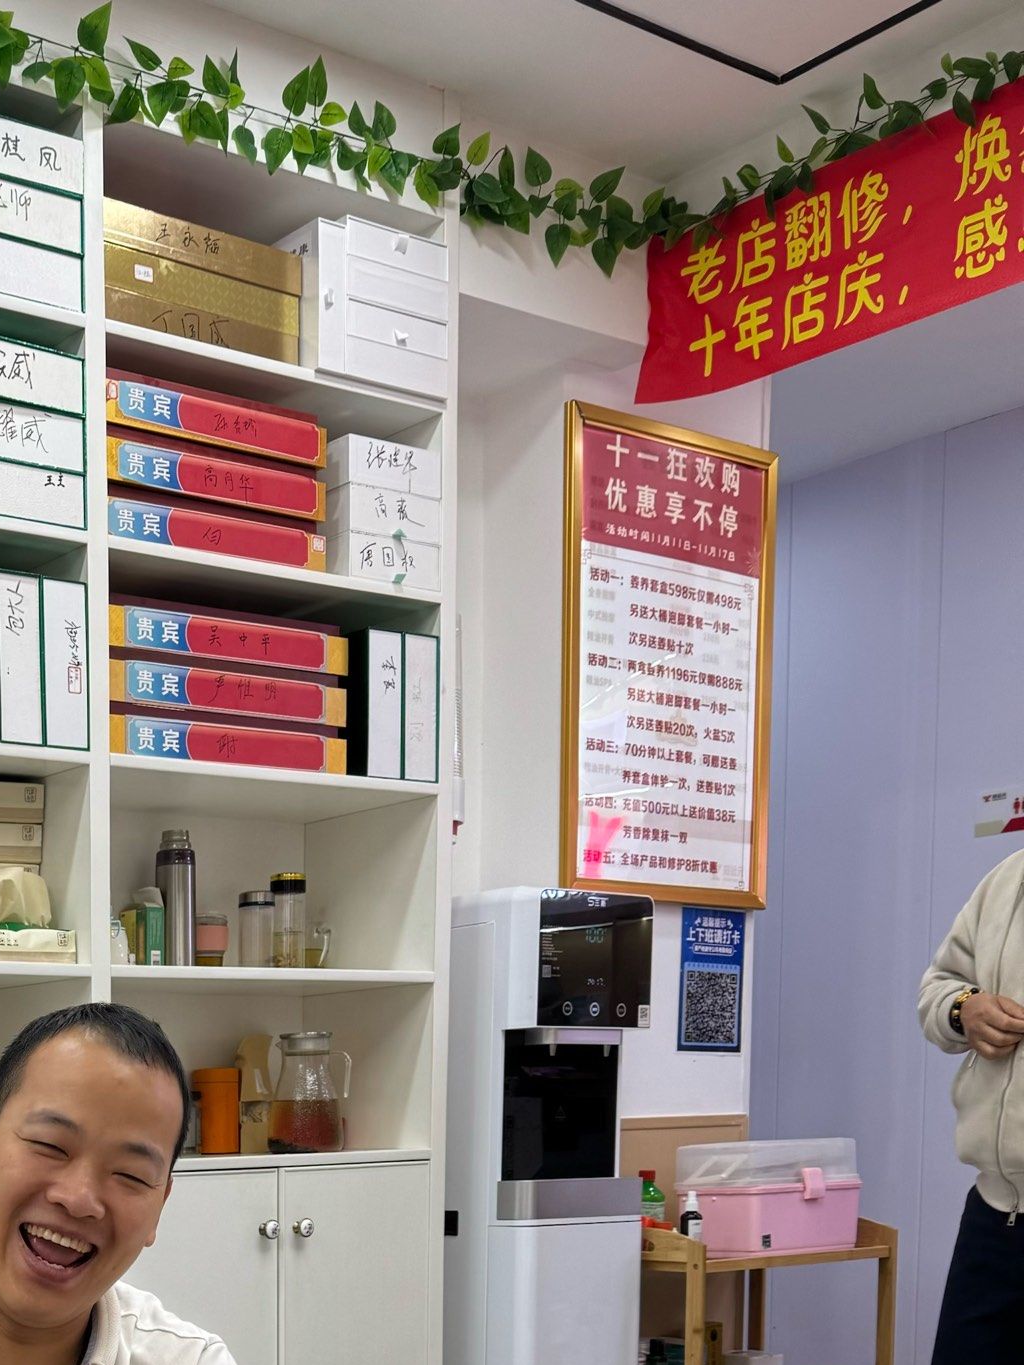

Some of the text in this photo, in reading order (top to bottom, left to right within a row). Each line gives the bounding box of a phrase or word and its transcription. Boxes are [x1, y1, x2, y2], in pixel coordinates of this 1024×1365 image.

[127, 386, 172, 420] 贵宾
[127, 450, 171, 484] 贵宾
[606, 434, 741, 497] 十一狂欢购
[604, 477, 739, 538] 优惠享不停
[117, 508, 161, 542] 贵宾
[605, 523, 736, 561] 活动时间11月11日-11月17日
[136, 617, 180, 644] 贵宾
[629, 603, 739, 636] 另送大桶泡脚套餐一小时一
[208, 625, 271, 656] 吴中平
[136, 667, 179, 697] 贵宾
[627, 687, 736, 716] 另送大桶泡脚套餐一小时一
[137, 726, 181, 752] 贵宾
[686, 926, 741, 945] 上下班请打卡
